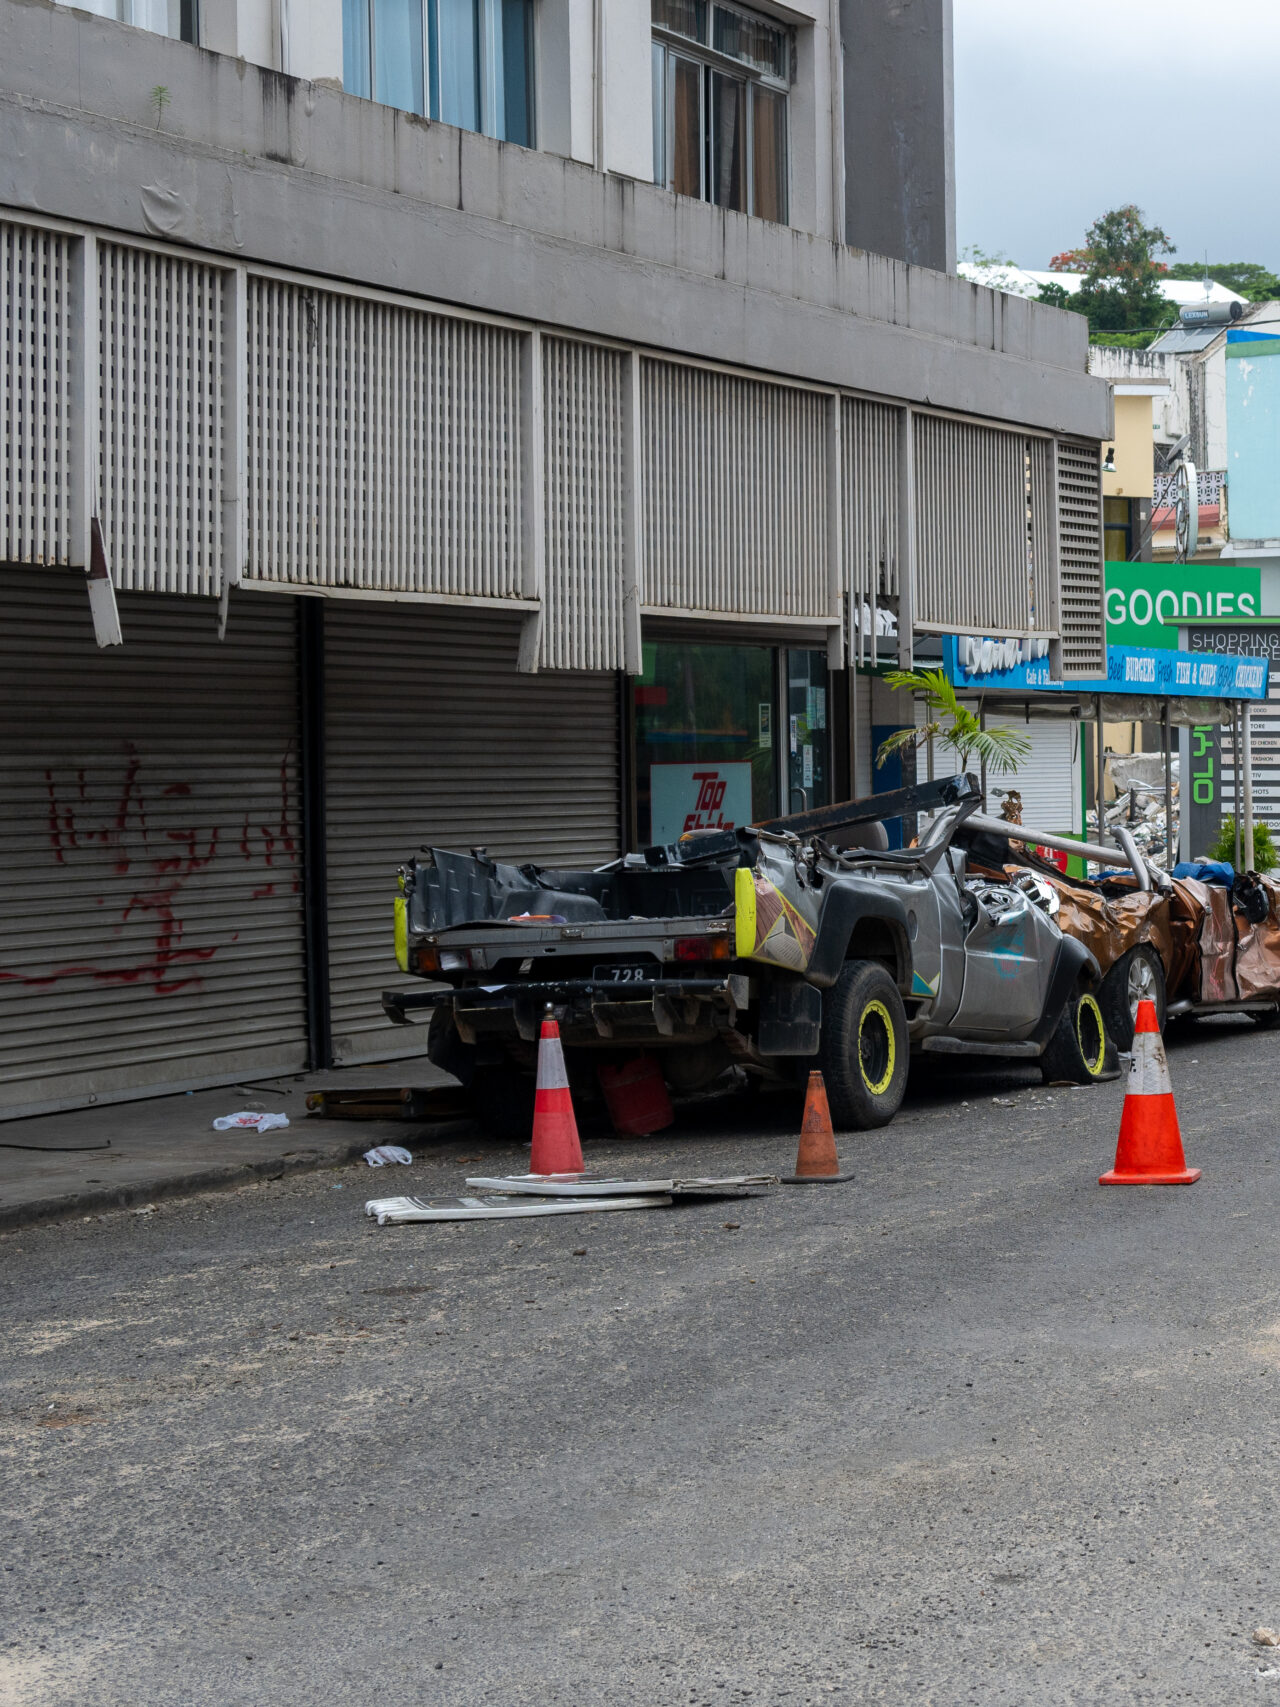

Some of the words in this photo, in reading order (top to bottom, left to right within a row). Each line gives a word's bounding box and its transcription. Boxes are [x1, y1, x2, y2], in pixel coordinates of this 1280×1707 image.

[1104, 587, 1256, 626] GOODIES
[1192, 633, 1280, 649] SHOPPING
[1107, 654, 1125, 682] Beef
[1125, 656, 1155, 682] BURGERS
[1157, 659, 1173, 683] Fresh
[1176, 661, 1191, 684] FISH
[1192, 662, 1198, 684] &
[1199, 663, 1217, 686] CHIPS
[1218, 664, 1234, 688] BBQ
[1235, 665, 1264, 688] CHICKENS
[692, 771, 728, 821] Top
[611, 968, 645, 983] 728
